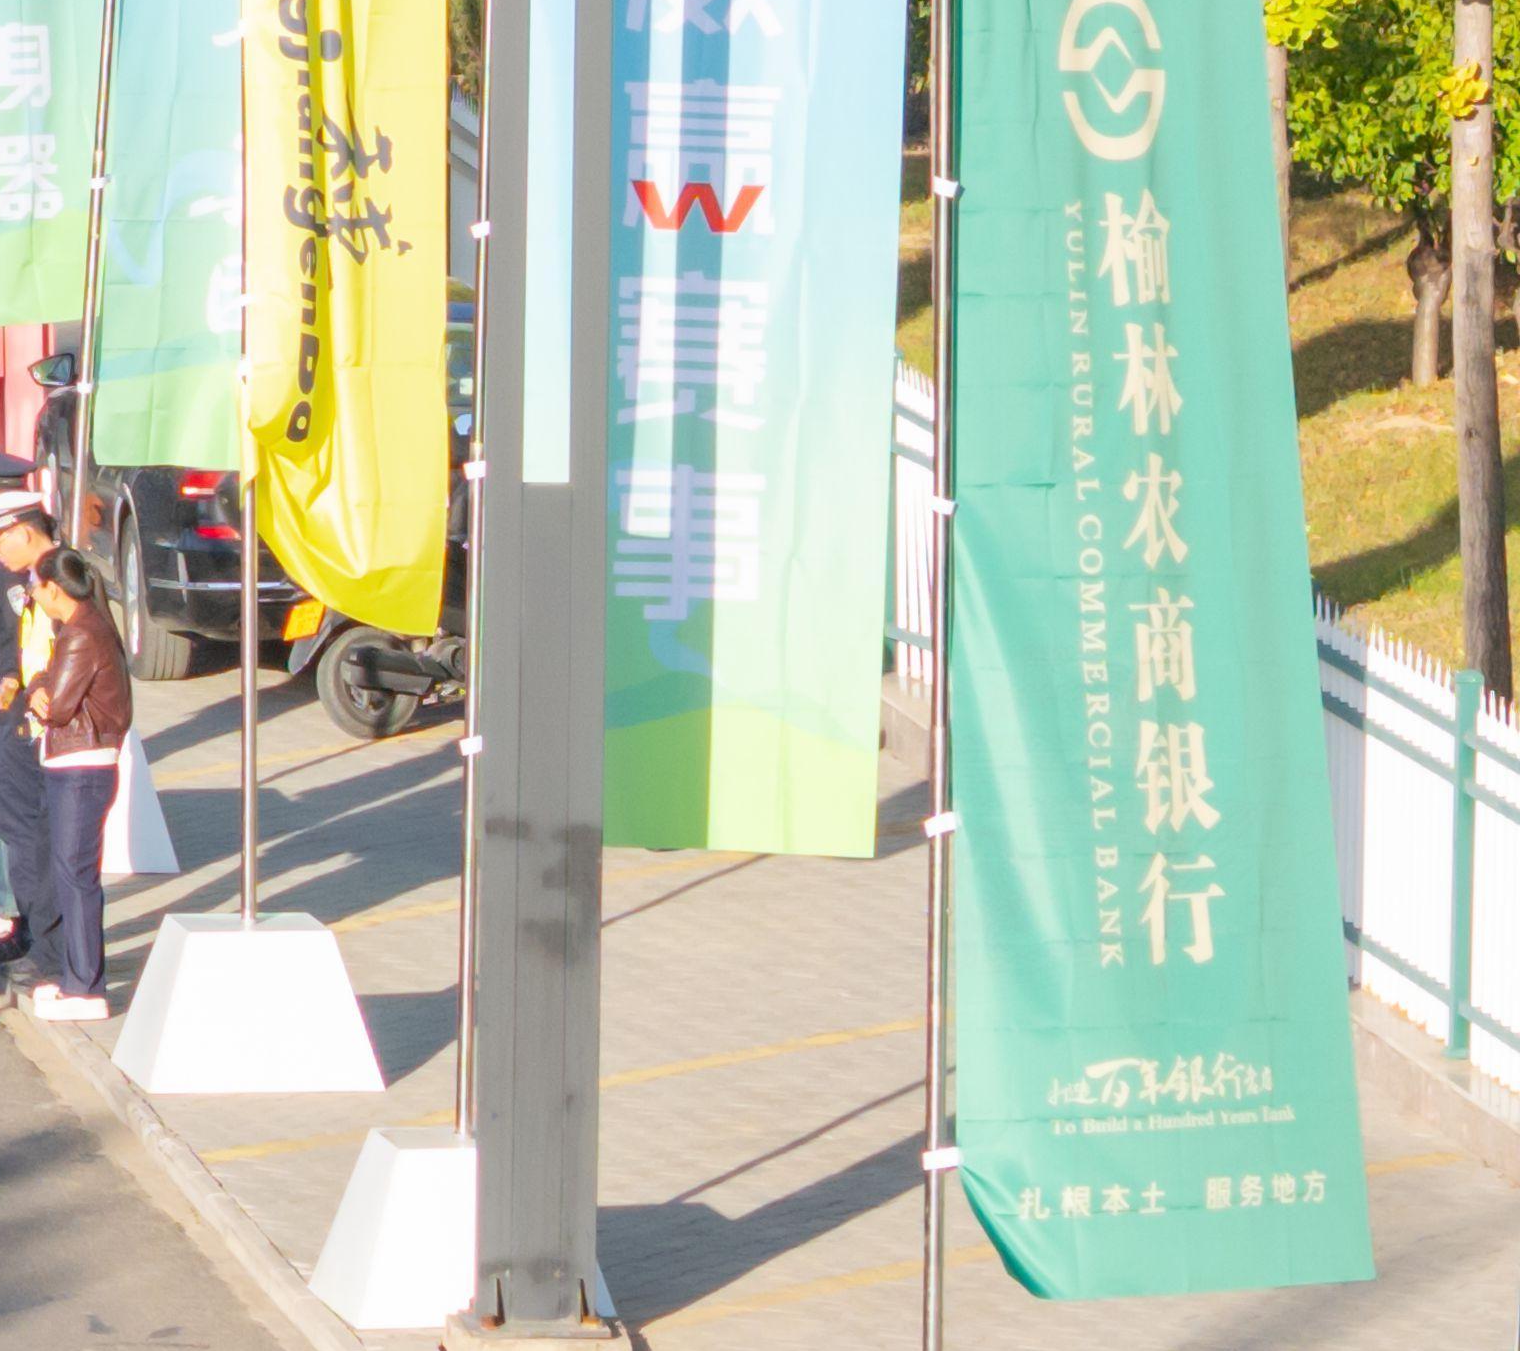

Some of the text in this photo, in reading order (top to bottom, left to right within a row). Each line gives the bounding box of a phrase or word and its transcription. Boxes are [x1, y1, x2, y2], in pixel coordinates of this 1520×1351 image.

[1063, 200, 1125, 969] YULIN RURAL COMMERCIAL BANK
[1097, 189, 1225, 967] 榆林农商银行
[1019, 1170, 1328, 1220] 扎根本土 服务地方
[1082, 1115, 1128, 1134] Build
[1148, 1109, 1215, 1131] Hundred
